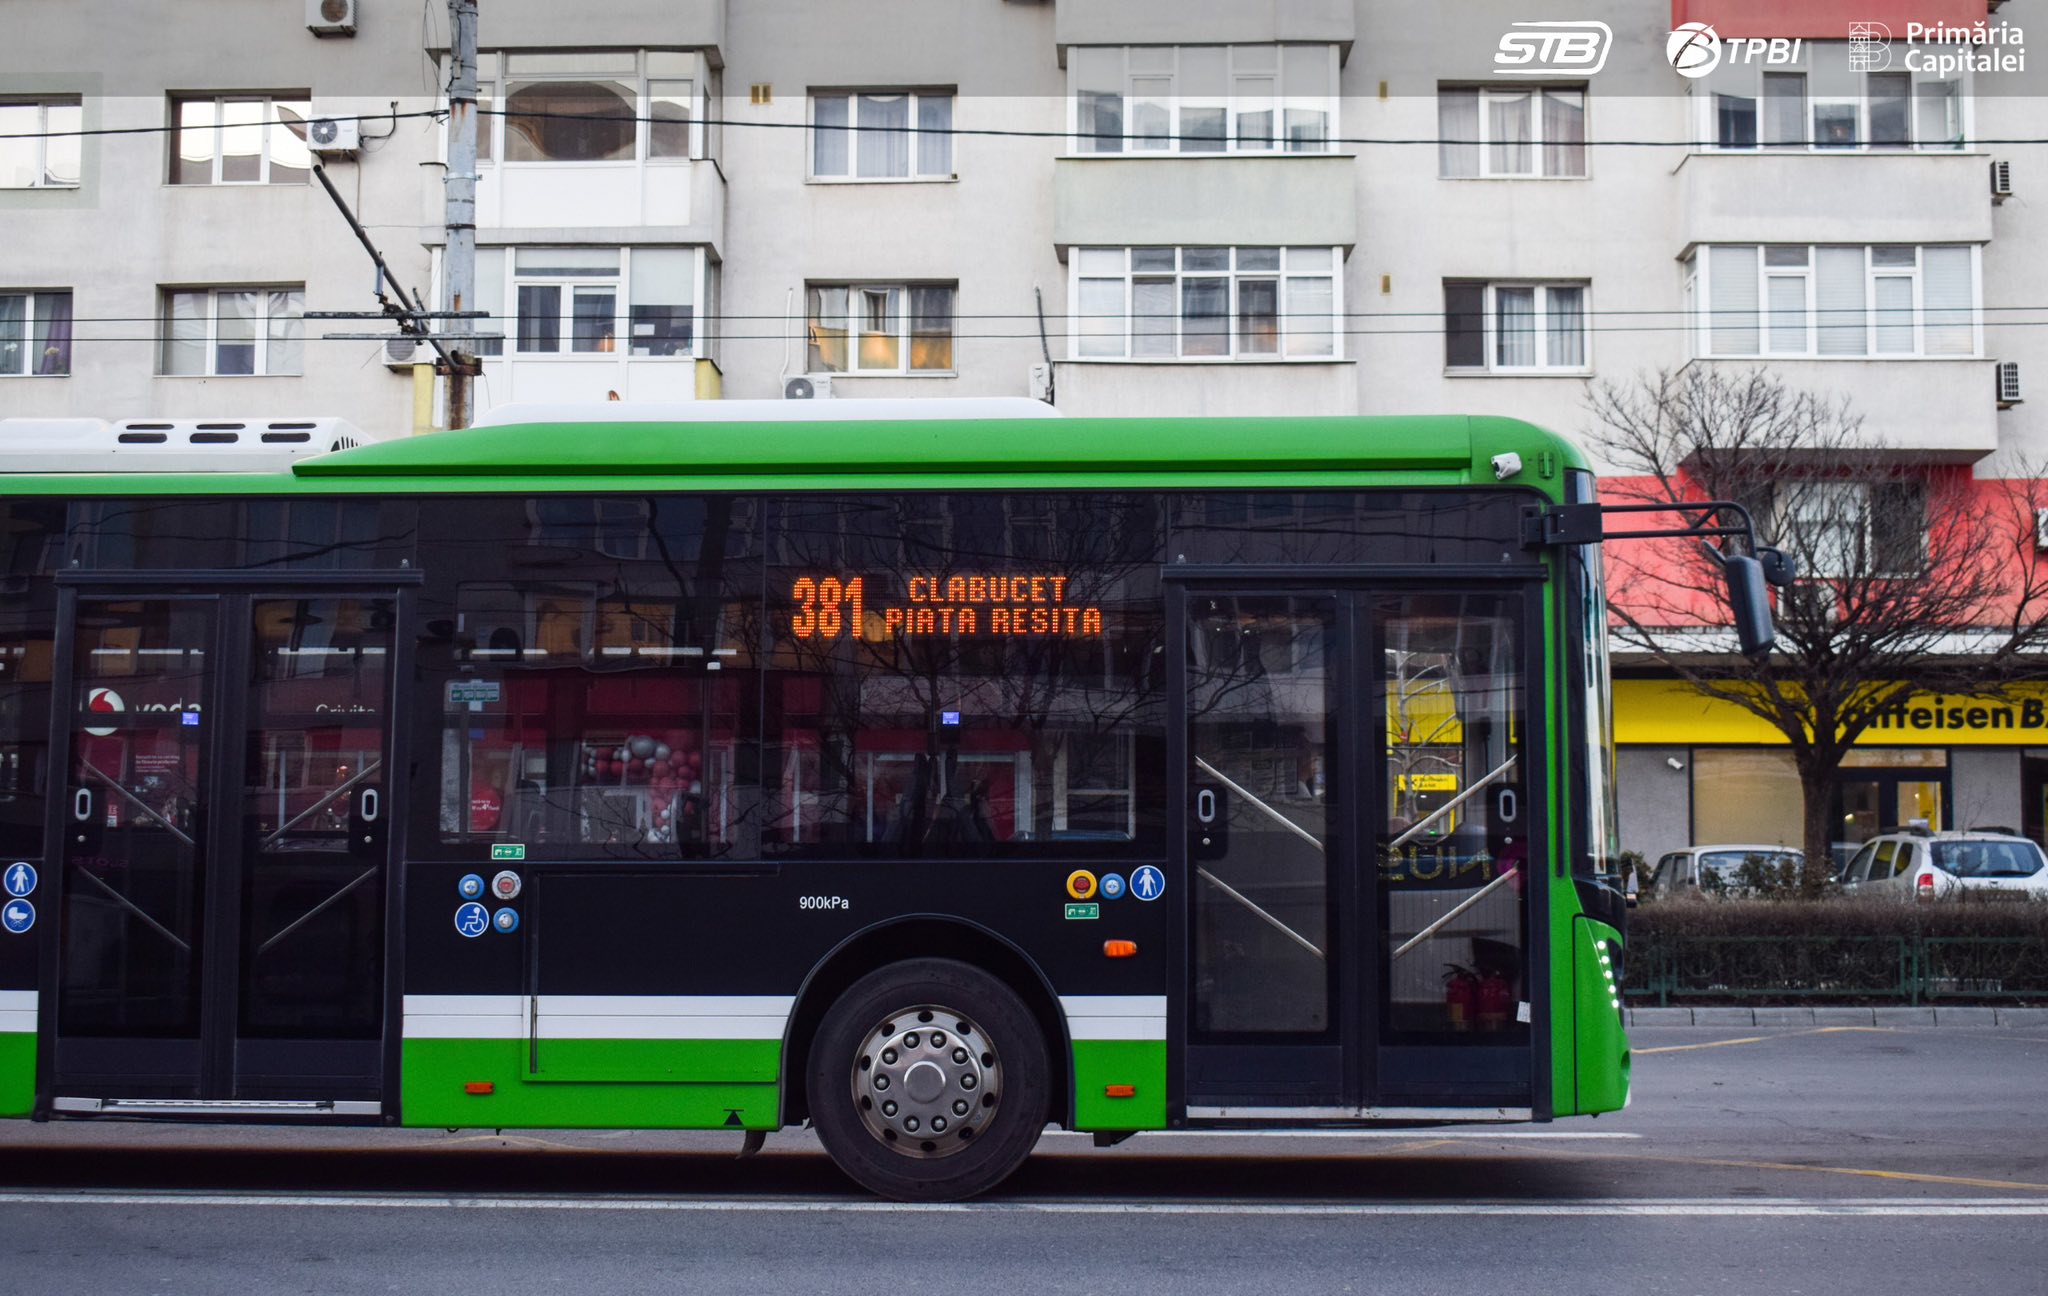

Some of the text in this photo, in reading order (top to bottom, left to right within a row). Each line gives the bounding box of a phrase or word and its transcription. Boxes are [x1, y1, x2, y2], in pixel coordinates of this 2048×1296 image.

[910, 576, 1066, 602] CLABUCET
[793, 577, 862, 637] 381
[886, 608, 1100, 633] PIATA RESITA
[1838, 697, 2048, 730] iffeisen B
[799, 896, 850, 911] 900kPa
